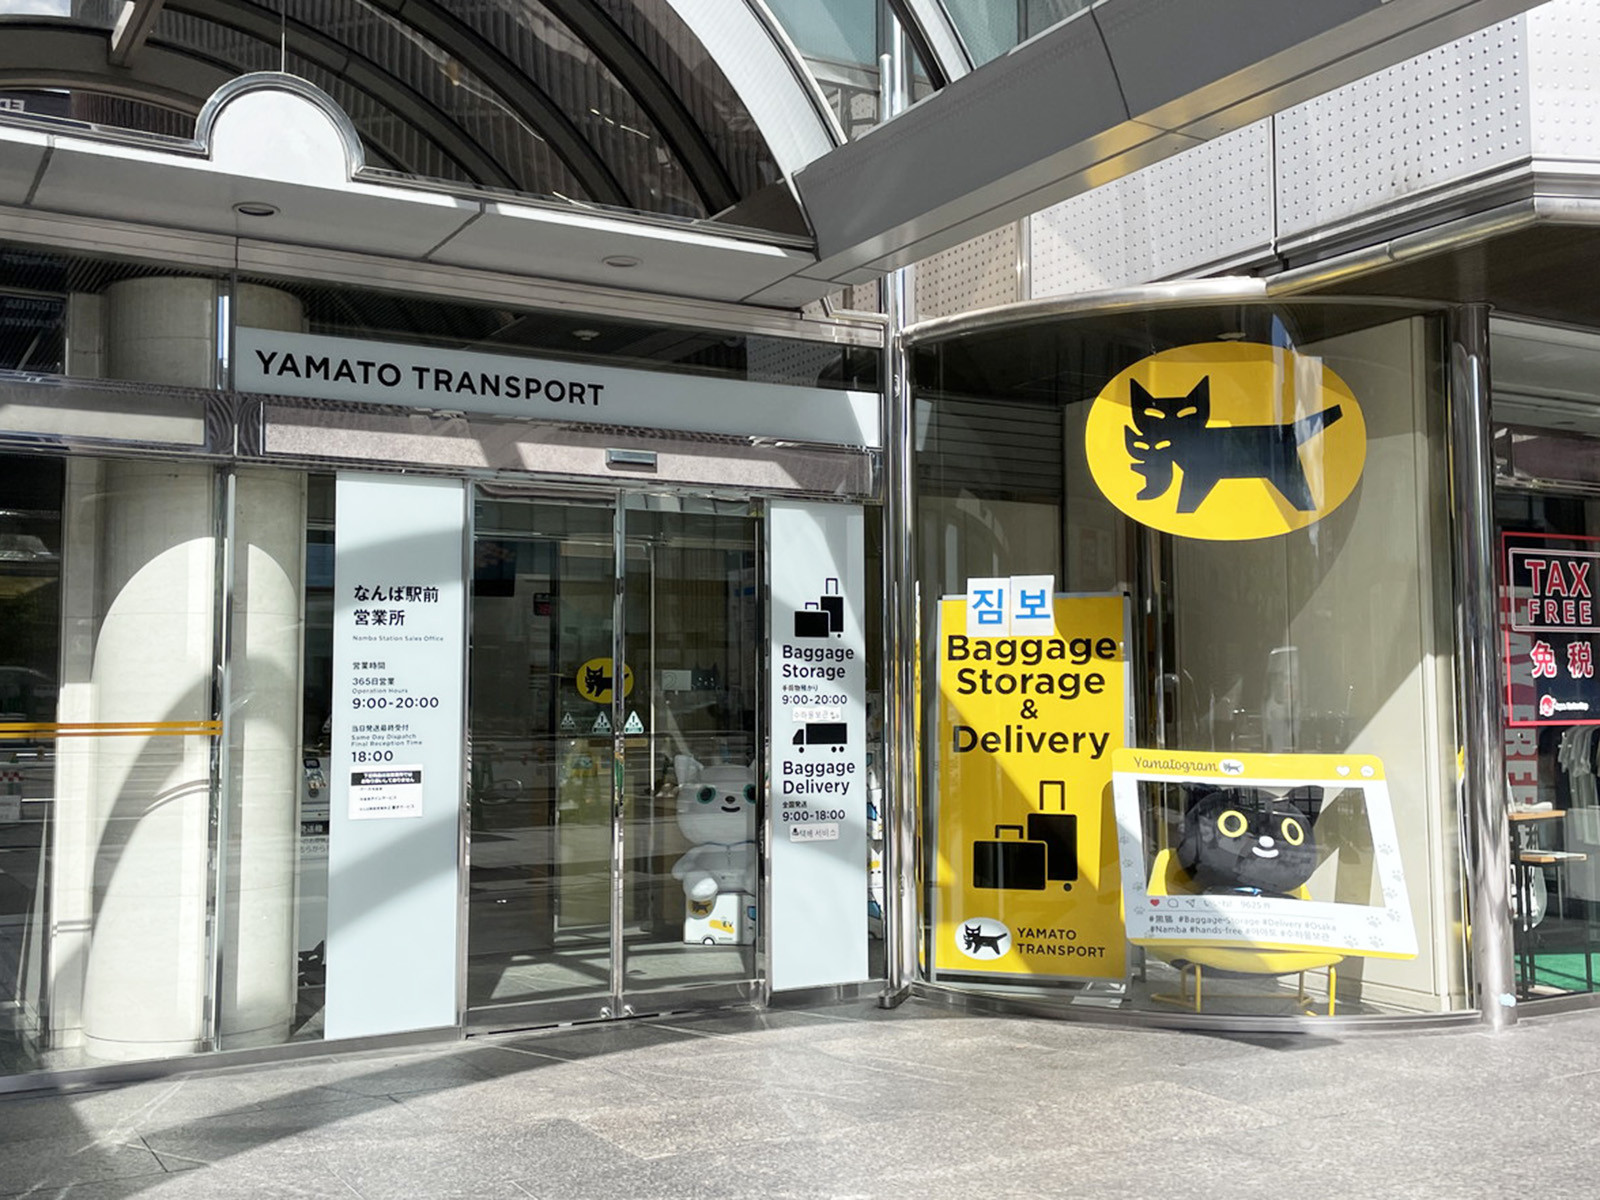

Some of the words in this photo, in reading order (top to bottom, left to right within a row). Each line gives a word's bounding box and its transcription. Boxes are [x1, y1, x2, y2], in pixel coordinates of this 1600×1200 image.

[254, 349, 402, 388] YAMATO
[411, 365, 605, 406] TRANSPORT
[1524, 559, 1592, 597] TAX
[353, 585, 439, 603] なんば駅前
[353, 609, 406, 626] 営業所
[1527, 598, 1592, 625] FREE
[782, 645, 854, 662] Baggage
[947, 635, 1117, 666] Baggage
[1530, 640, 1594, 678] 免税
[352, 661, 386, 670] 営業時間
[782, 663, 846, 681] Storage
[352, 677, 395, 686] 365日営業
[956, 667, 1106, 700] Storage
[351, 687, 387, 695] Operation
[781, 694, 848, 705] 9:00-20:00
[352, 696, 439, 709] 9:00-20:00
[1019, 698, 1039, 720] &
[952, 724, 1110, 760] Delivery
[351, 750, 394, 763] 18:00
[1133, 755, 1218, 774] Yamatogram
[783, 761, 855, 778] Baggage
[783, 779, 850, 796] Delivery
[782, 801, 808, 809] 全国発送
[782, 809, 846, 822] 9:00-18:00
[1150, 925, 1187, 933] #Namba
[1189, 926, 1243, 936] #hands-free
[1262, 918, 1302, 929] #Delivery
[1304, 921, 1337, 931] #Osaka
[1017, 927, 1077, 941] YAMATO
[1017, 943, 1106, 958] TRANSPORT
